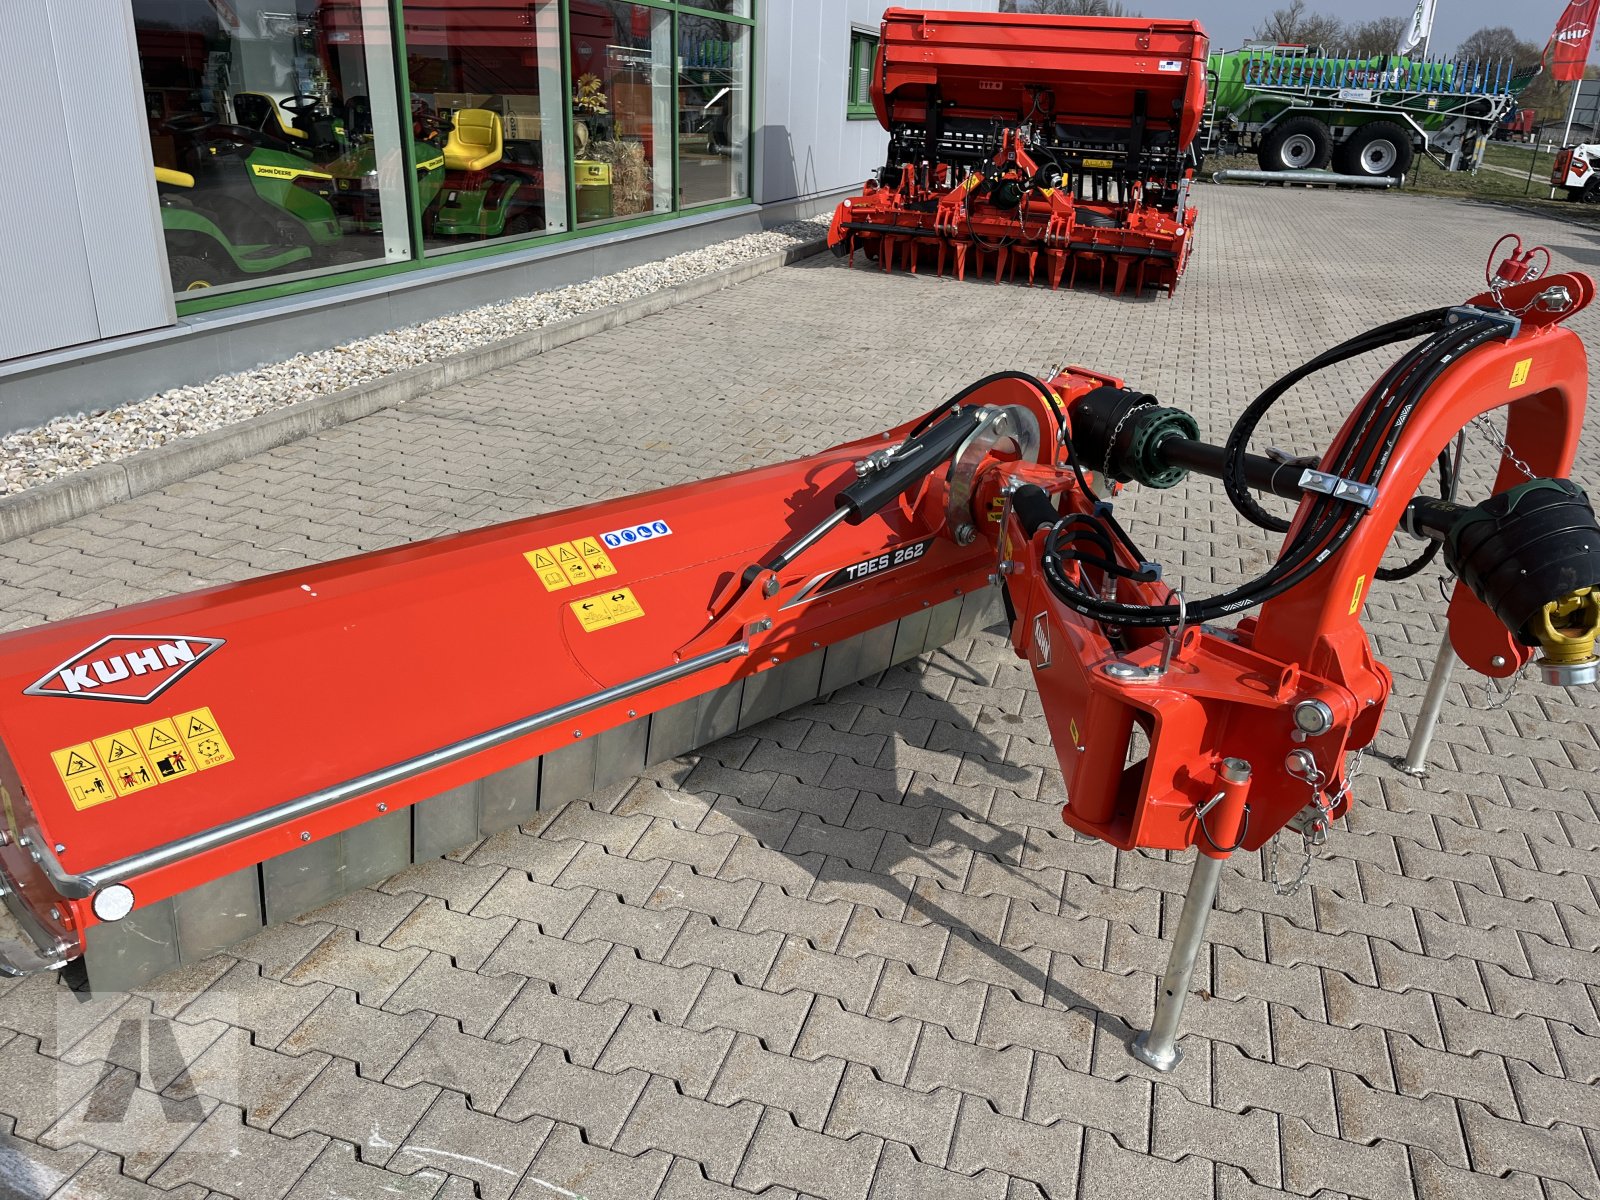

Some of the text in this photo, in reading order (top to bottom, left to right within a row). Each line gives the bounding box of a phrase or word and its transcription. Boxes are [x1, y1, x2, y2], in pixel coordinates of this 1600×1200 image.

[846, 542, 925, 580] TBES 262
[60, 639, 197, 694] KUHN
[204, 753, 226, 765] STOP
